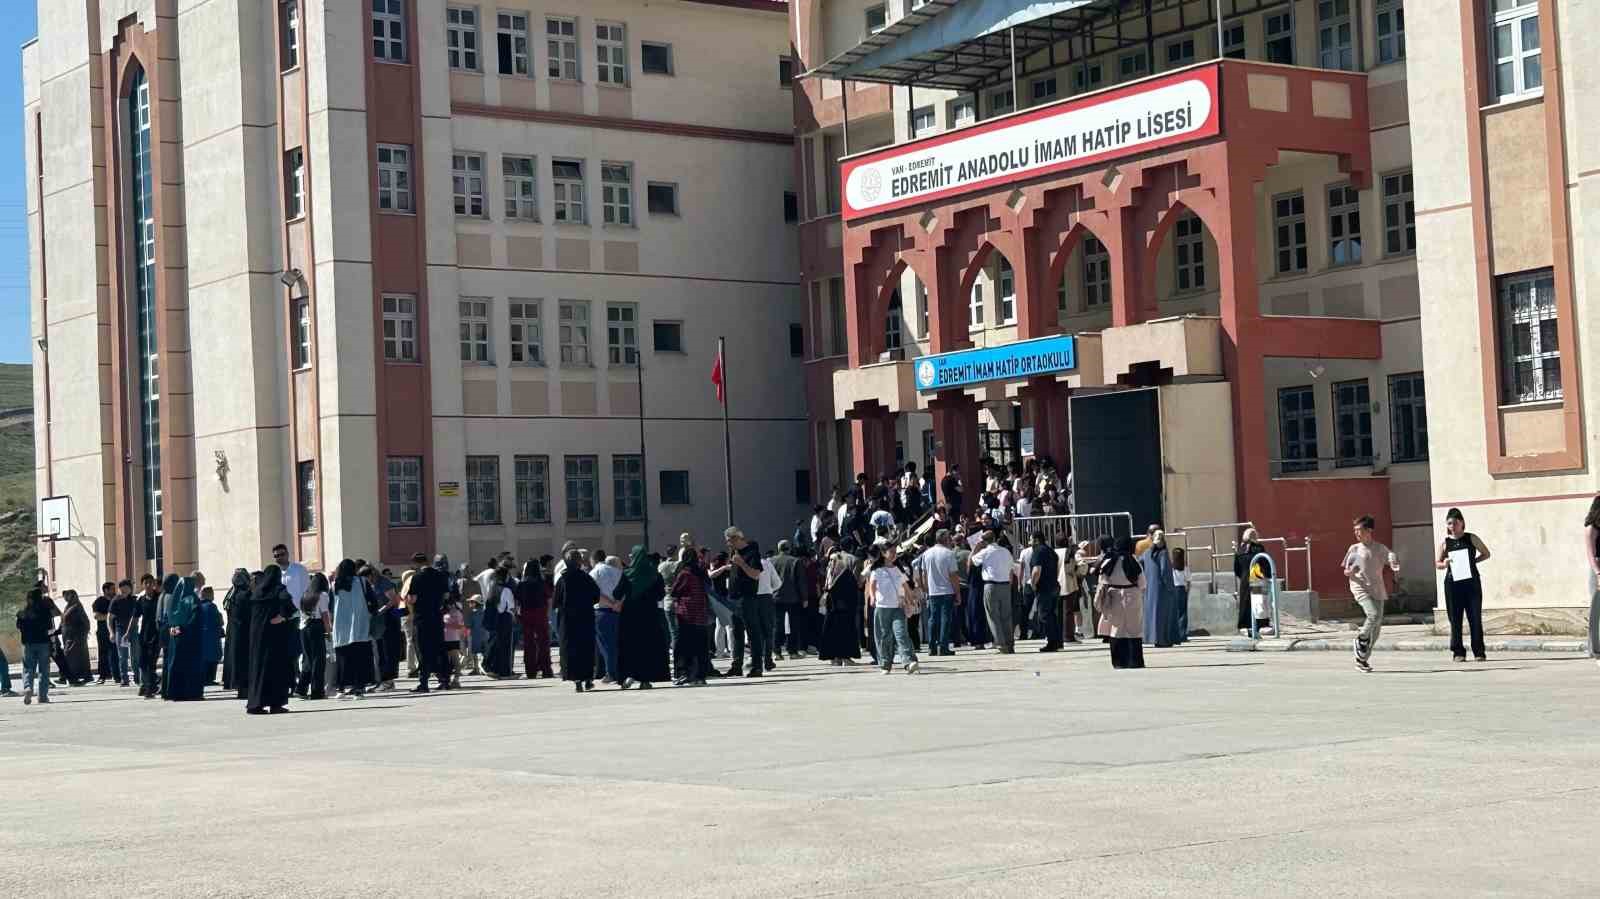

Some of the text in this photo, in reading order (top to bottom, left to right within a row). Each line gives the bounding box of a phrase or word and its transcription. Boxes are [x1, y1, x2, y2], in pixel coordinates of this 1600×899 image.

[891, 101, 1192, 198] EDREMİT ANADOLU İMAM HATİP LİSESİ
[891, 166, 904, 176] VAN
[938, 351, 1070, 385] EDREMİT İMAM HATİP ORTAOKULU
